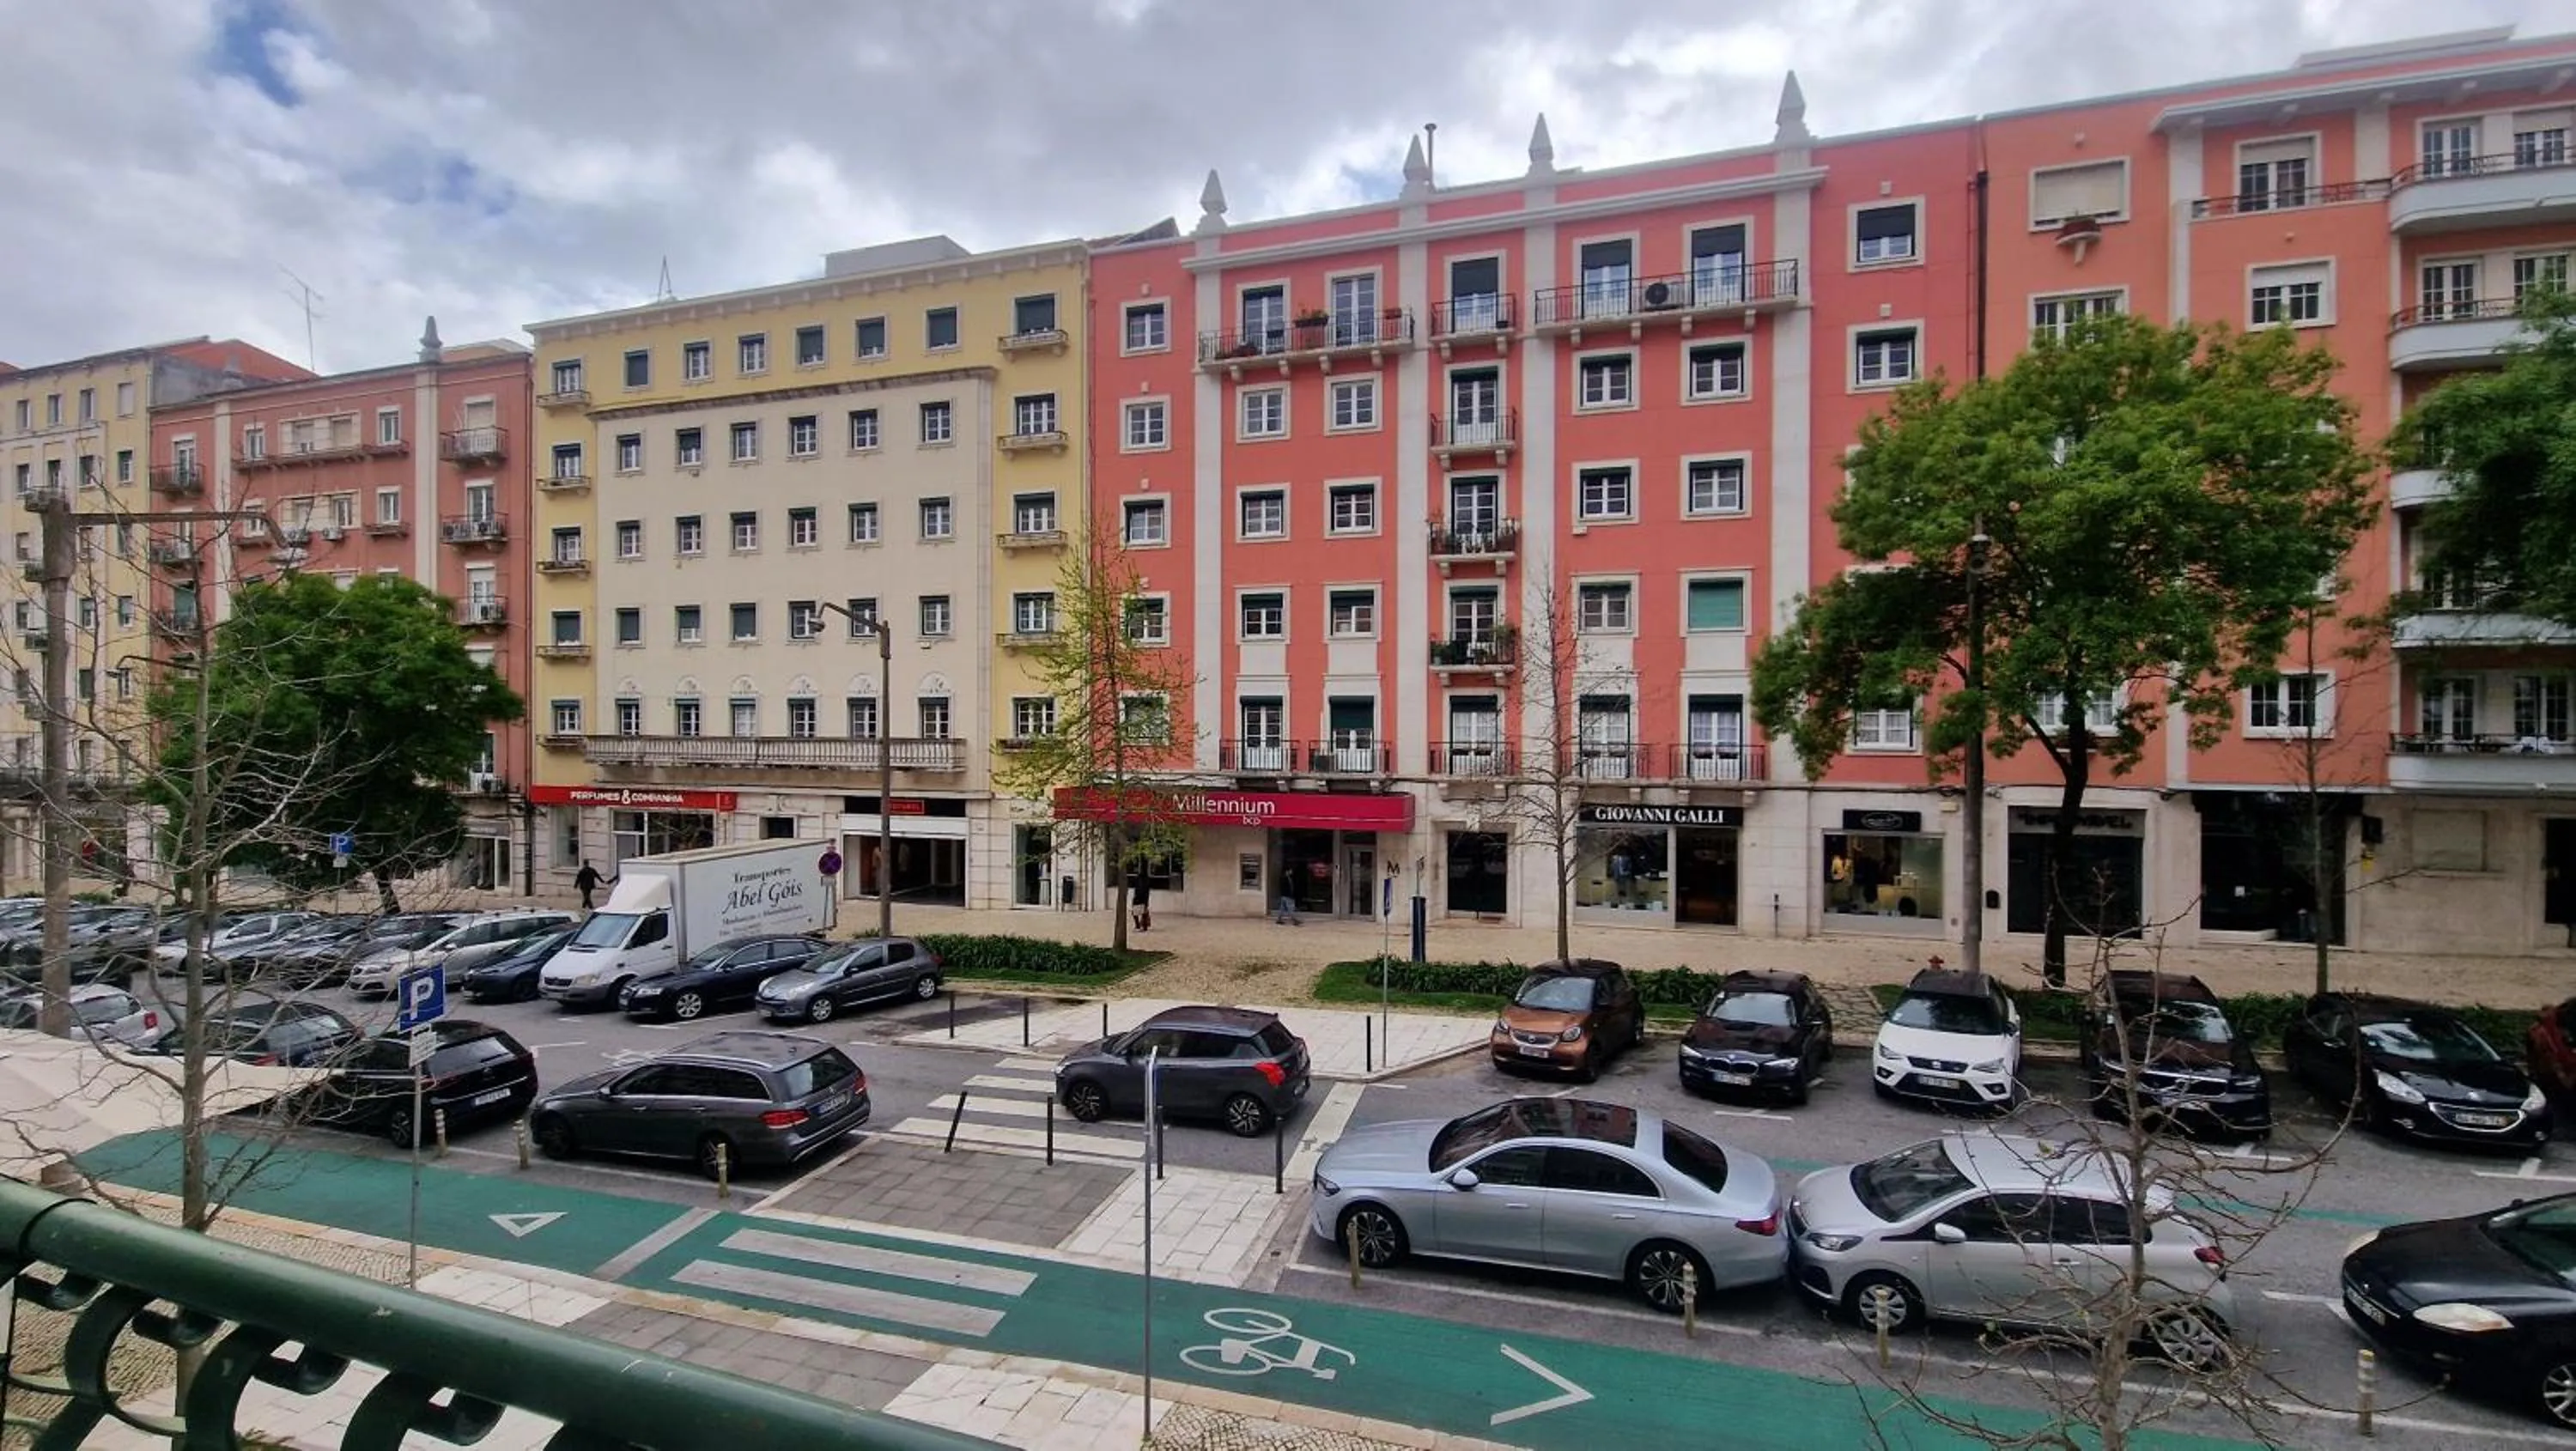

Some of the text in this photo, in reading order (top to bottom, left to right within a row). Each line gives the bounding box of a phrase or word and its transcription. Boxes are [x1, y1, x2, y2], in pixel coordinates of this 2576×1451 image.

[570, 790, 619, 802] PERFUMES
[622, 789, 631, 804] &
[1172, 794, 1275, 815] Millennium
[1595, 806, 1724, 823] GIOVANNI GALLI
[721, 882, 767, 914] Abel
[410, 976, 434, 1021] P
